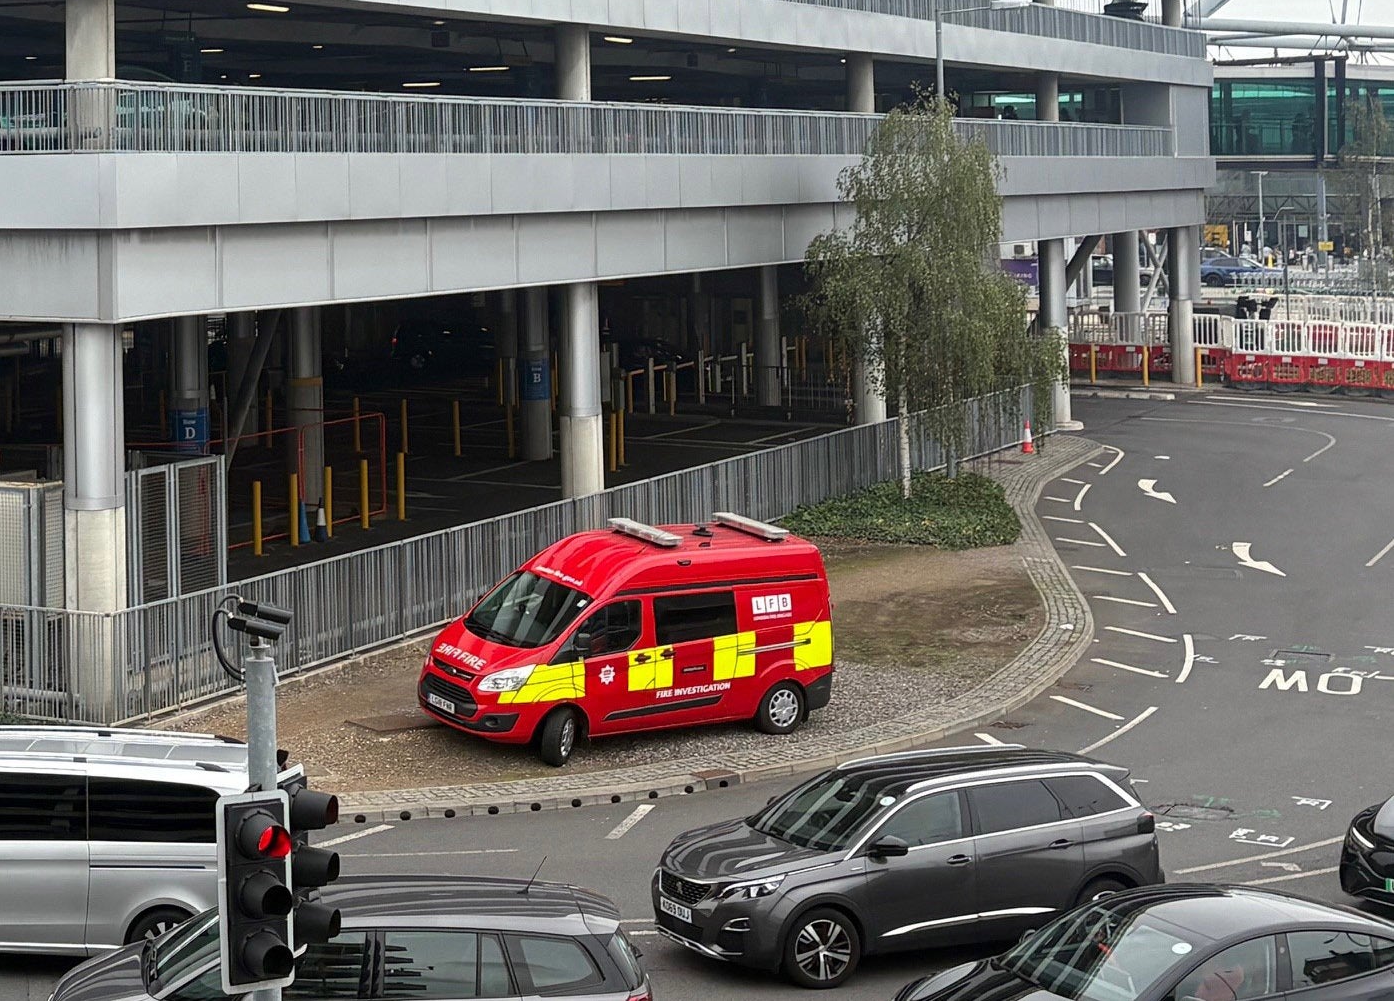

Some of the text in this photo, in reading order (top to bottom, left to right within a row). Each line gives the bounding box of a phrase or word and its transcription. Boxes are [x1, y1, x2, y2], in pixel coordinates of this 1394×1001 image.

[185, 426, 196, 439] D
[756, 597, 788, 610] LFB
[457, 651, 487, 671] FIRE
[656, 681, 731, 699] FIRE INVESTIGATION
